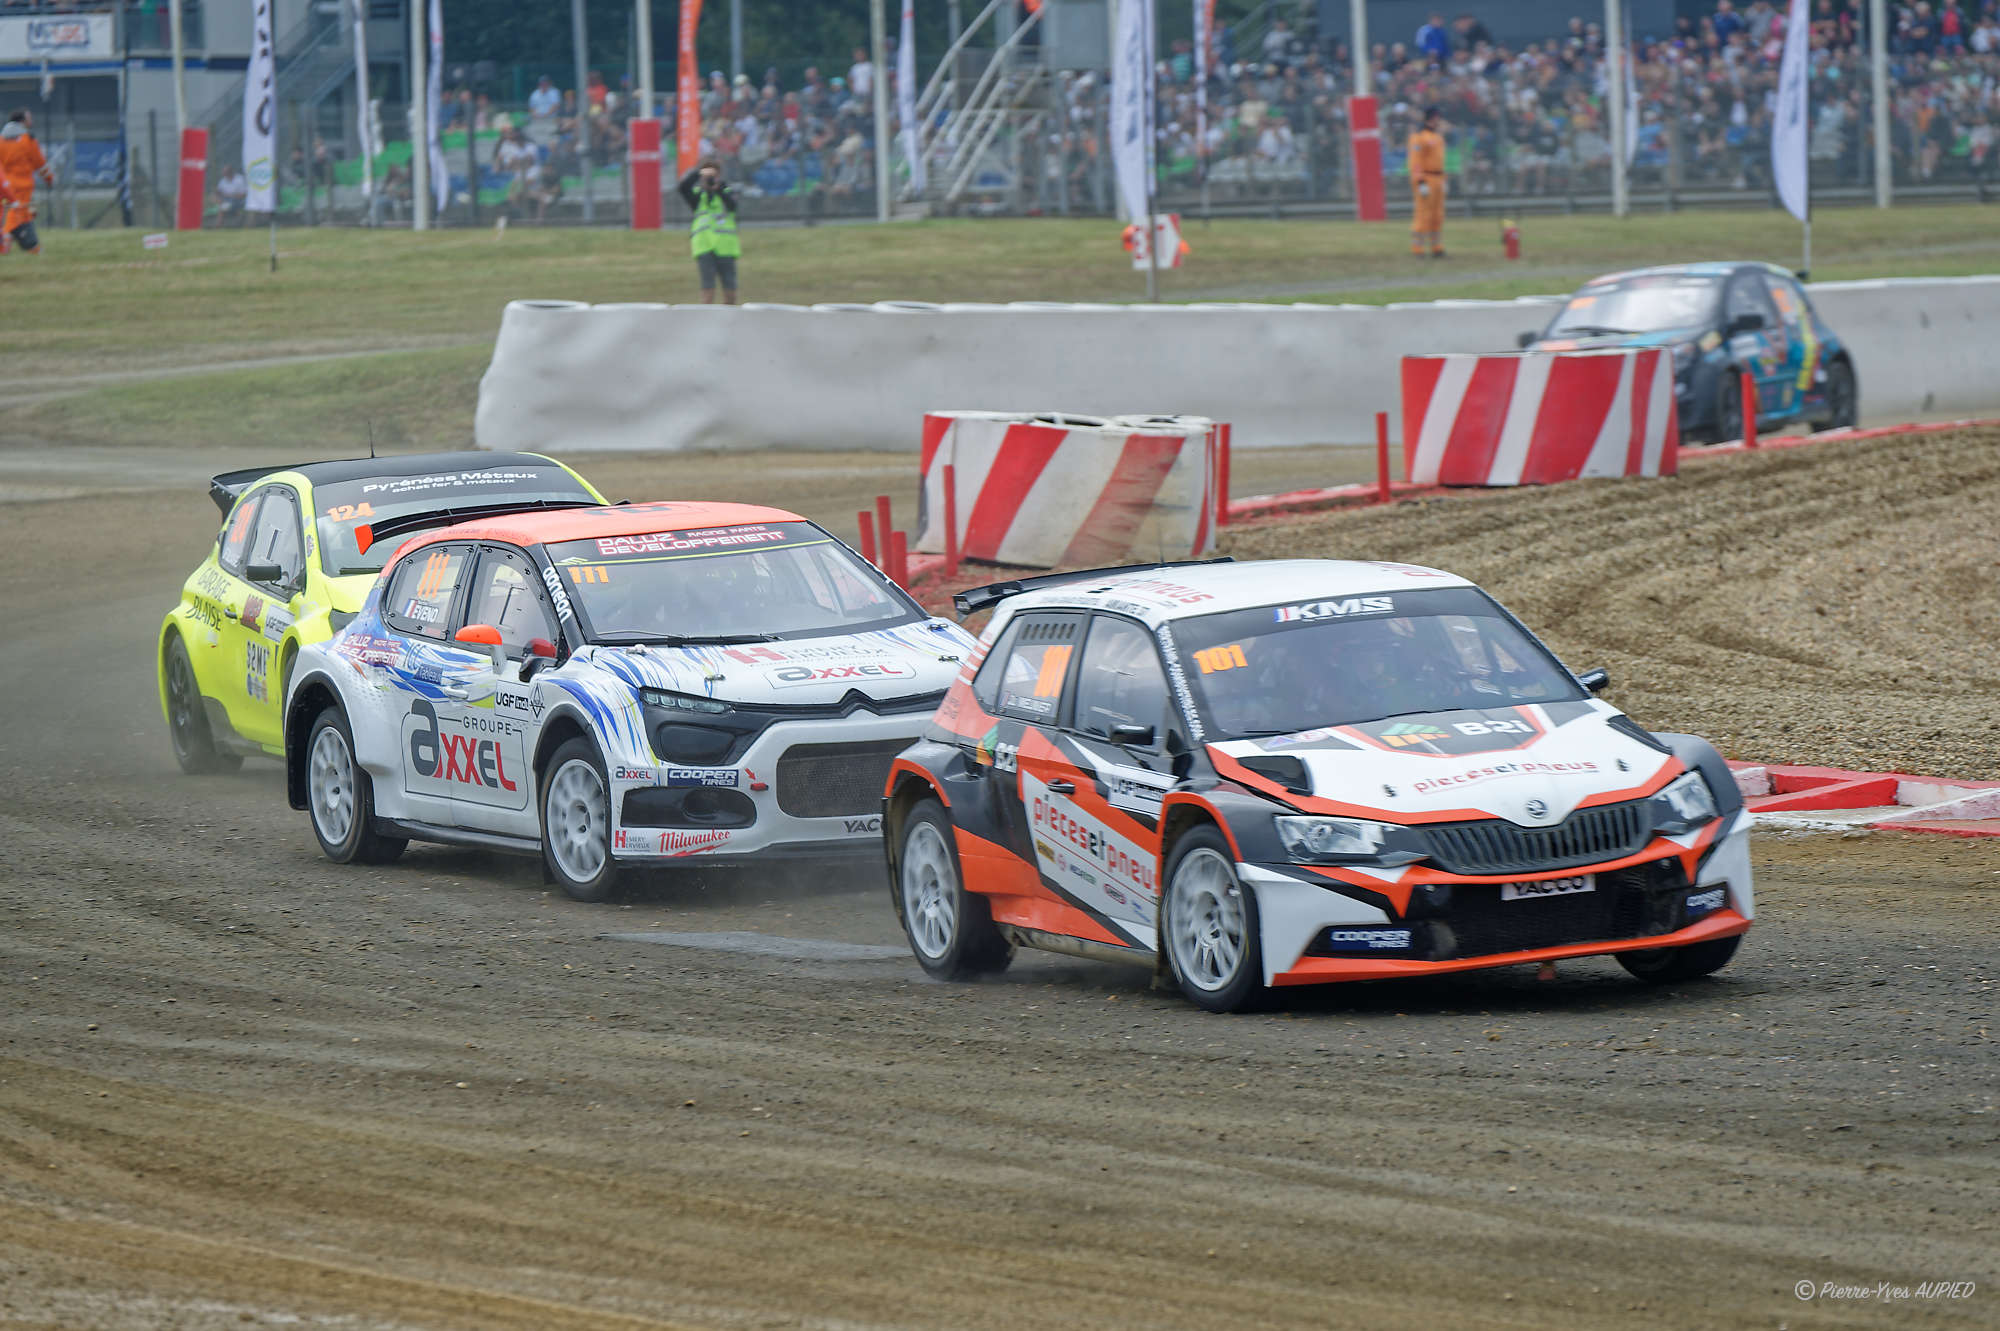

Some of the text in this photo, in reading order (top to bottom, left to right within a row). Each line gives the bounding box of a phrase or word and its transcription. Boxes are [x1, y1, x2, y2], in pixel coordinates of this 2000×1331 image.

[363, 472, 537, 493] Pyrénées Métaux
[327, 502, 376, 522] 124
[598, 532, 675, 547] DALUZ
[730, 526, 766, 534] PARTS
[601, 531, 786, 555] DEVELOPPEMENT
[568, 566, 609, 584] 111
[185, 595, 221, 631] BLAISE
[1288, 597, 1394, 621] KMS
[1193, 645, 1248, 674] 101
[496, 692, 514, 707] UGF
[463, 716, 512, 735] GROUPE
[669, 770, 737, 779] COOPER
[1412, 760, 1599, 794] piecesetpneus
[844, 818, 884, 833] YAC
[658, 829, 731, 853] Milwaukee
[1332, 931, 1411, 941] COOPER
